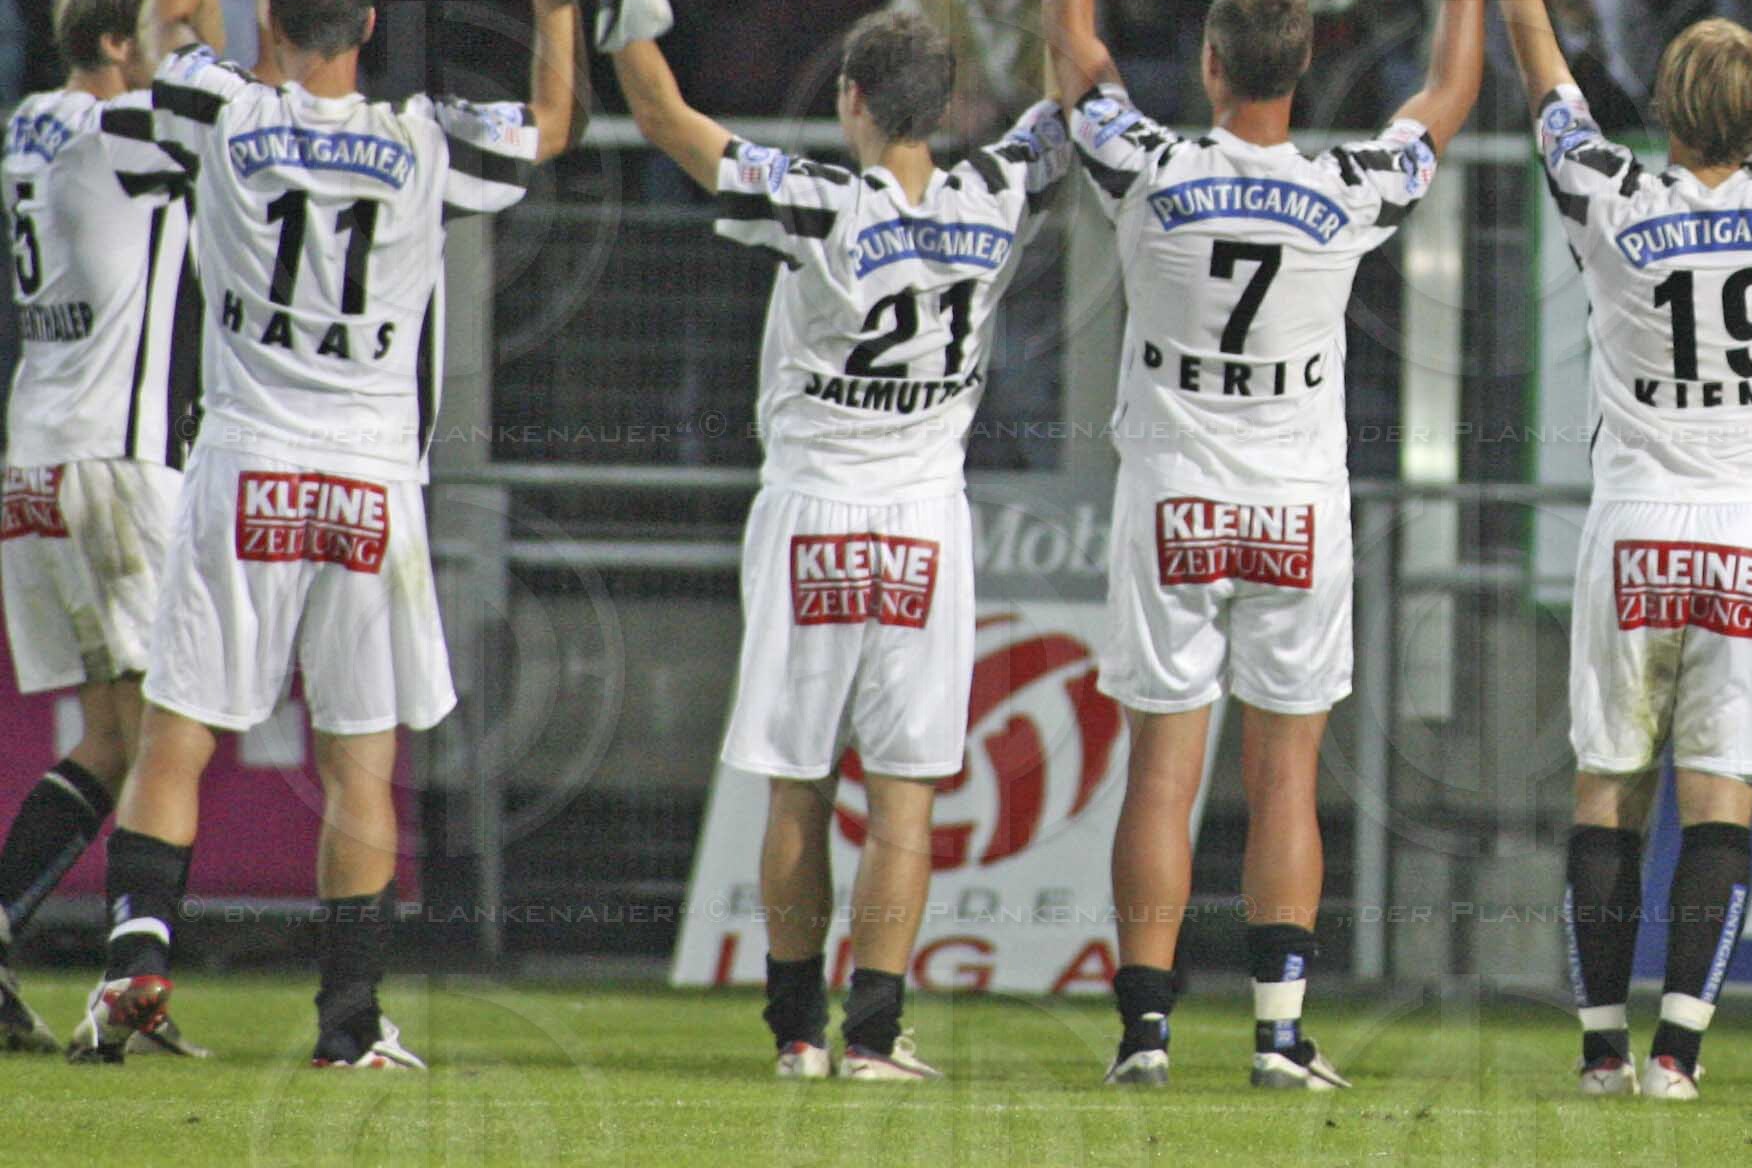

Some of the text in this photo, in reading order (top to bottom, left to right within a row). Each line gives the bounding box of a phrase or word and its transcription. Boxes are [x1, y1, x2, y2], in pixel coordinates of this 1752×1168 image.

[1154, 184, 1343, 240] PUNTIGAMER
[267, 190, 378, 314] 11
[222, 289, 395, 359] HAAS
[1210, 240, 1282, 354] 7
[845, 280, 977, 378] 21
[1143, 340, 1325, 396] DERIC
[245, 479, 385, 530] KLEINE
[1163, 501, 1309, 543] KLEINE
[1166, 546, 1307, 579] ZEITUNG
[800, 590, 924, 620] ZEITNG
